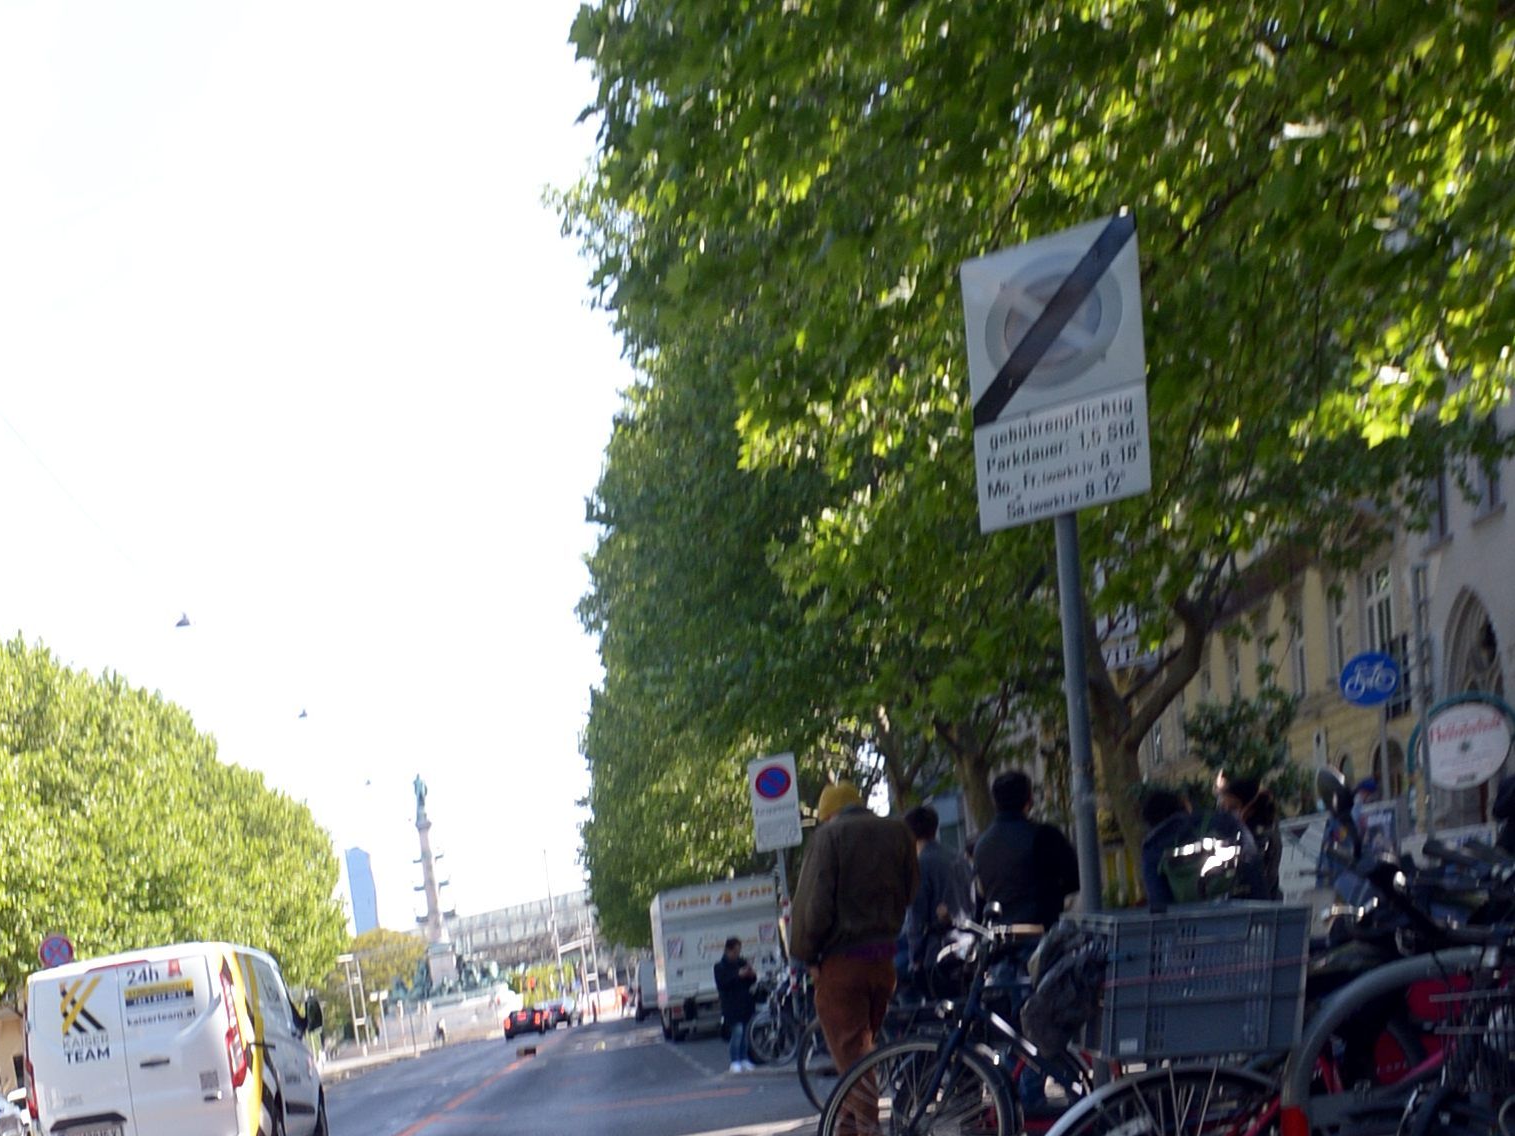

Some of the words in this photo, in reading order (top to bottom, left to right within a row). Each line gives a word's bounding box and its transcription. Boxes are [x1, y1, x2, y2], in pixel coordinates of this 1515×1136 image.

[990, 397, 1133, 452] gebührenpflichtig
[127, 964, 160, 986] 24h
[64, 1047, 111, 1066] TEAM
